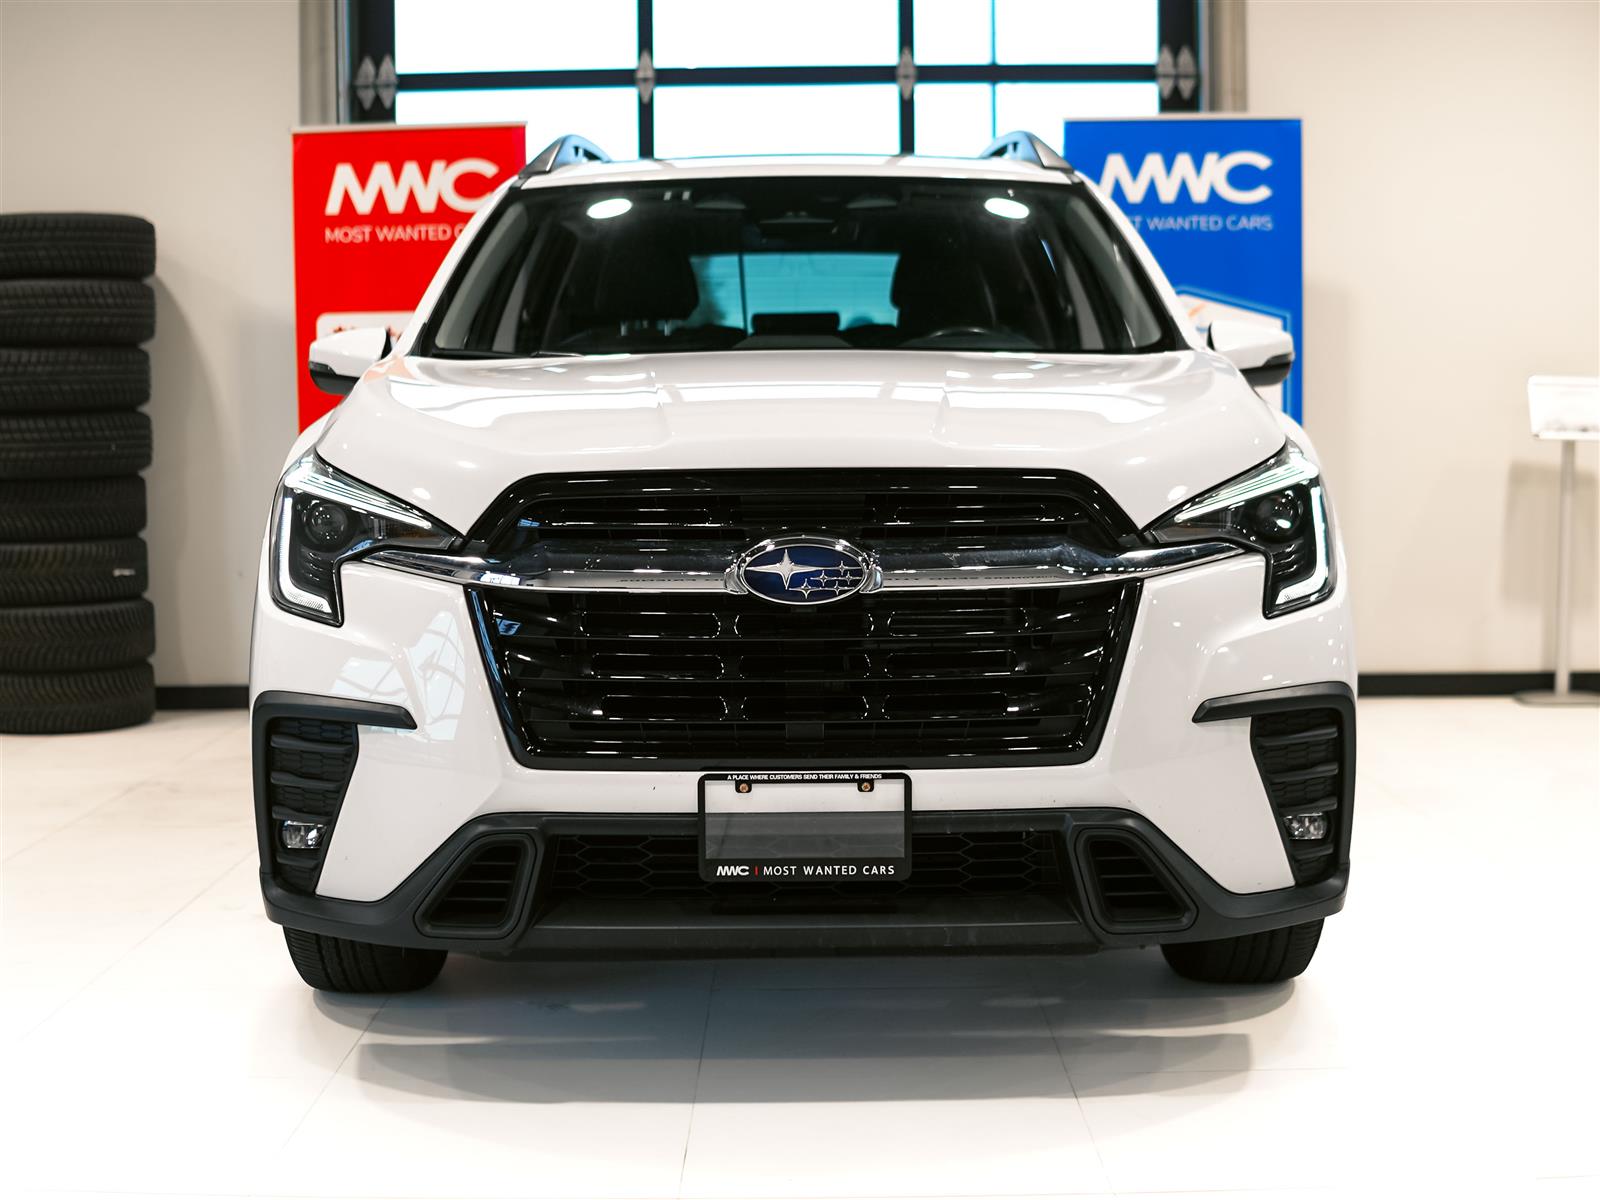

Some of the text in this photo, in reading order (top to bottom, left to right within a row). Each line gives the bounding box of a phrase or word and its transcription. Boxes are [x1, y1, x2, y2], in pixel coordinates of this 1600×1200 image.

[325, 158, 499, 216] MWC
[1100, 151, 1273, 204] MWC
[1147, 214, 1223, 231] WANTED
[1226, 214, 1273, 231] CARS
[324, 225, 372, 243] MOST
[375, 223, 451, 242] WANTED
[716, 865, 895, 876] MWC MOST WANTED CARS
